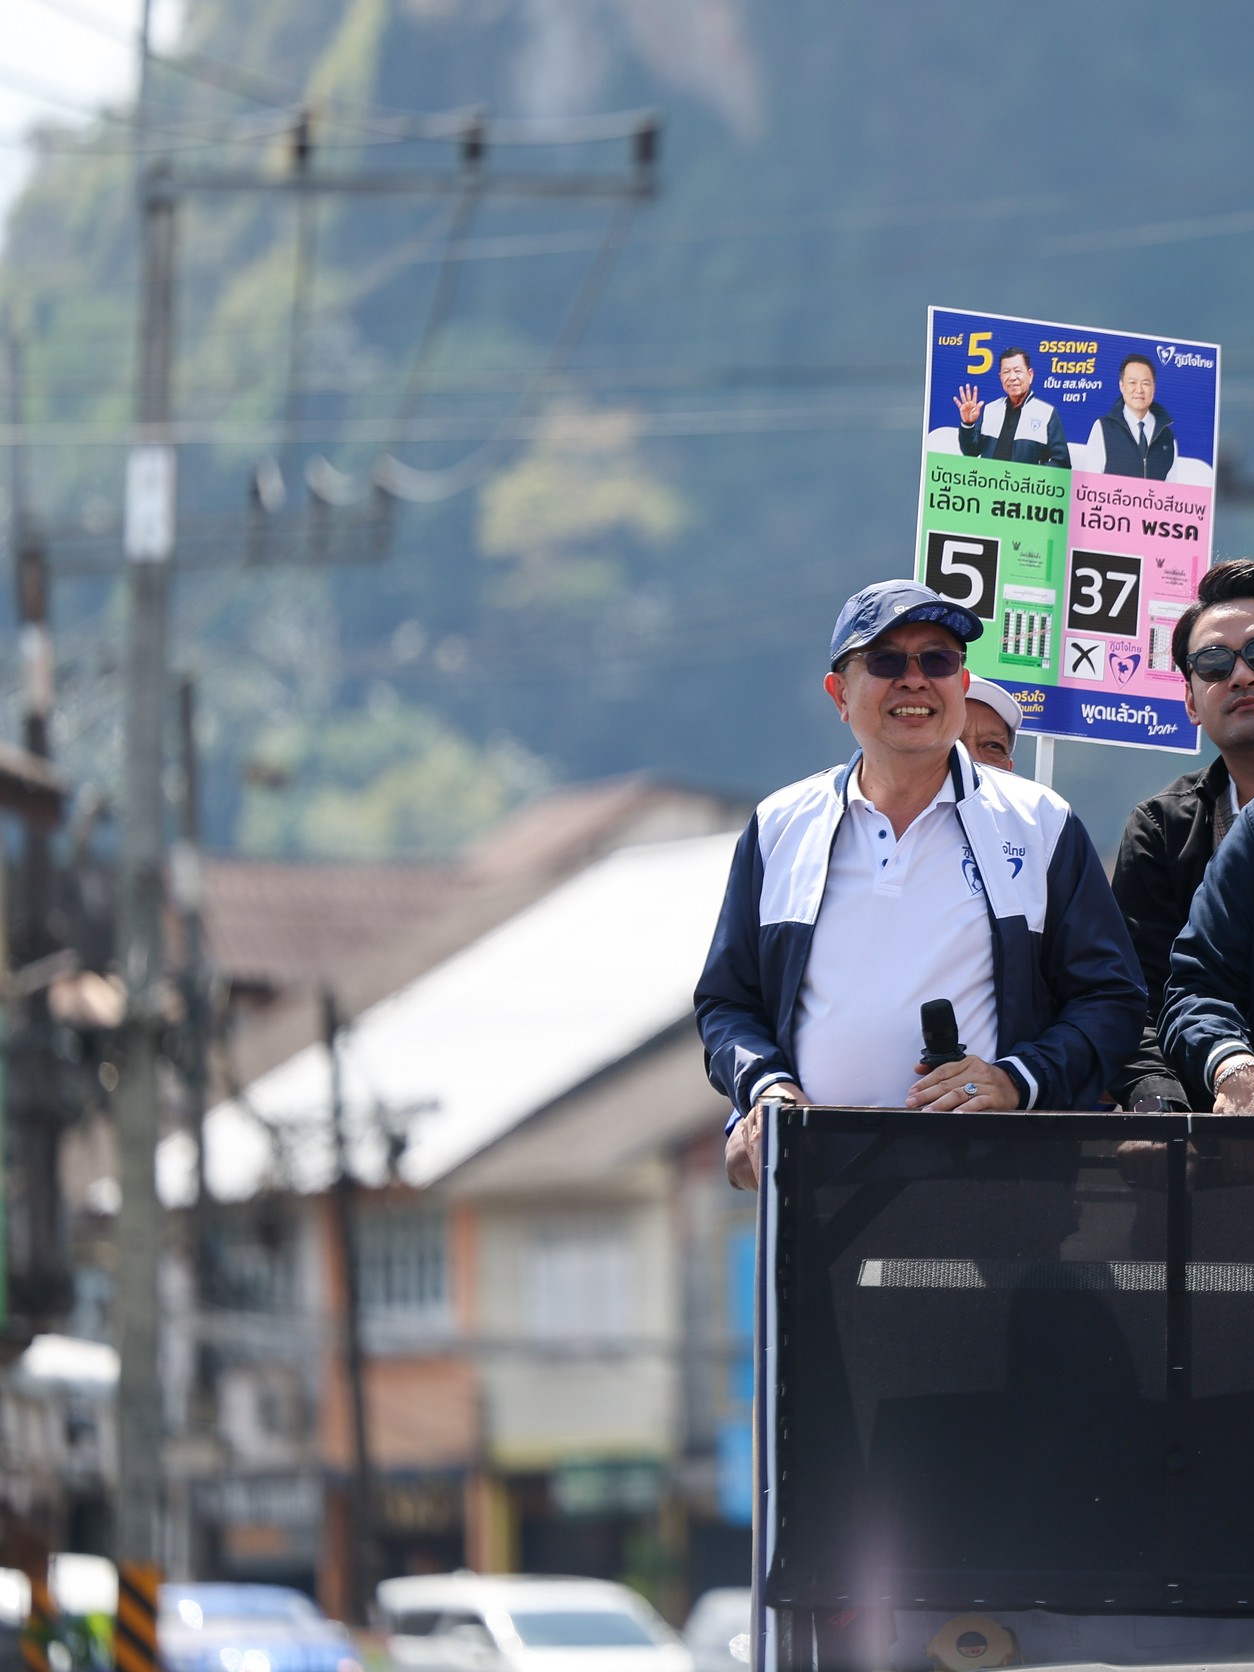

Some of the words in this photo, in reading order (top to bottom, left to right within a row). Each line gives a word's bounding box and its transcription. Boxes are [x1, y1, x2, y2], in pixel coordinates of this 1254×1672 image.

[938, 333, 964, 346] เบอร์
[1039, 340, 1098, 354] อรรถพล
[967, 332, 994, 374] 5
[1174, 352, 1214, 369] ภูมิใจไทย
[1051, 357, 1096, 374] ไตรศรี
[1044, 376, 1061, 389] เป็น
[1062, 377, 1102, 390] สส.พังงา
[1063, 393, 1080, 403] เขต
[1082, 393, 1087, 402] 1
[931, 465, 1065, 498] บัตรเลือกตั้งสีเขียว
[929, 486, 981, 514] เลือก
[991, 500, 1065, 525] สส.เขต
[1076, 484, 1206, 521] บัตรเลือกตั้งสีชมพู
[1080, 505, 1131, 533] เลือก
[1141, 519, 1199, 542] พรรค
[938, 539, 985, 609] 5
[1071, 566, 1138, 618] 37
[1012, 690, 1046, 703] จริงใจ
[1081, 702, 1158, 725] พูดแล้วทำ
